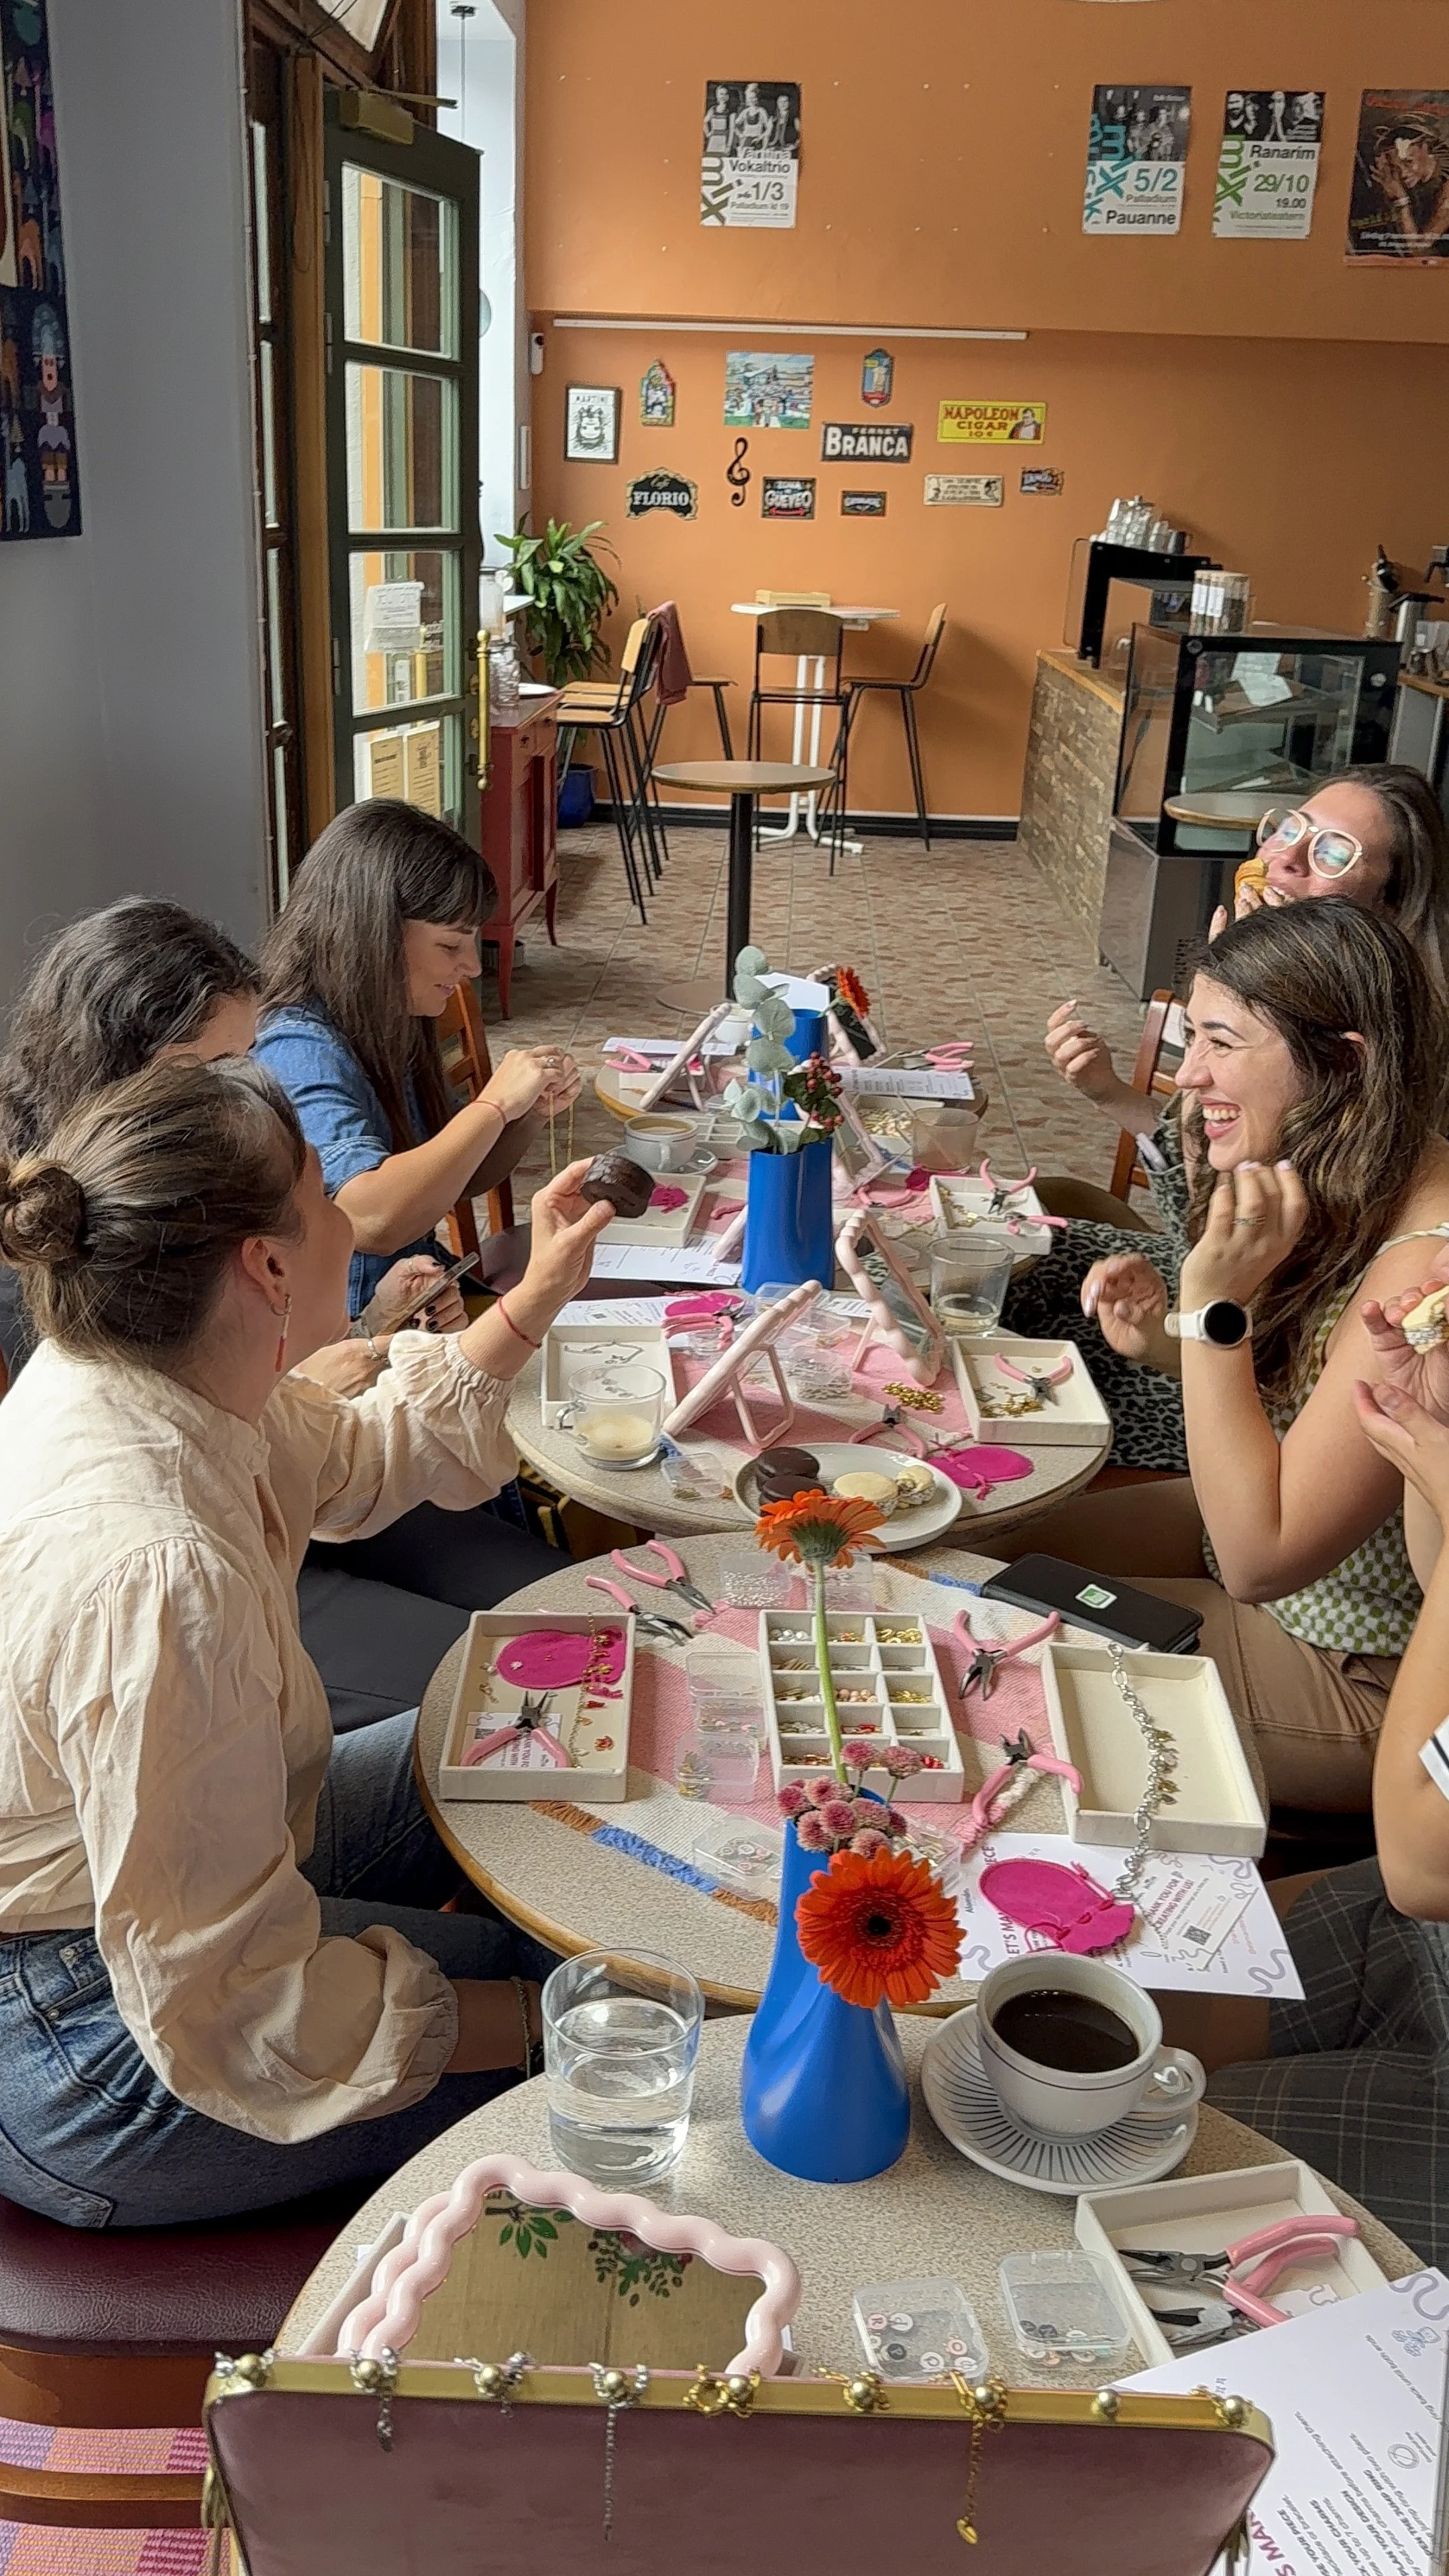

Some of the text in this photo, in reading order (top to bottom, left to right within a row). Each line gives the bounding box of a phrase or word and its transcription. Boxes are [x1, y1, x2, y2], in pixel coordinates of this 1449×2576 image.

[1249, 144, 1316, 160] Ranarim
[751, 181, 784, 201] 1/3
[1134, 168, 1178, 193] 5/2
[1253, 173, 1310, 193] 29/10
[1106, 210, 1177, 225] Pauanne
[943, 407, 1020, 421] NAPOLEON
[957, 421, 1008, 431] CIGAR
[826, 426, 908, 457] BRANCA
[633, 490, 690, 506] FLORIO
[981, 1845, 997, 1865] IECE
[1002, 1934, 1020, 1953] ET'S
[1362, 2468, 1385, 2491] RING
[1340, 2488, 1371, 2524] DESIGN
[1379, 2491, 1405, 2518] JUMP
[1276, 2508, 1301, 2536] PIECE
[1308, 2498, 1342, 2539] CHARMS
[1399, 2516, 1417, 2536] THE
[1365, 2522, 1389, 2551] YOUR
[1296, 2535, 1320, 2563] YOUR
[1337, 2537, 1360, 2566] YOUR
